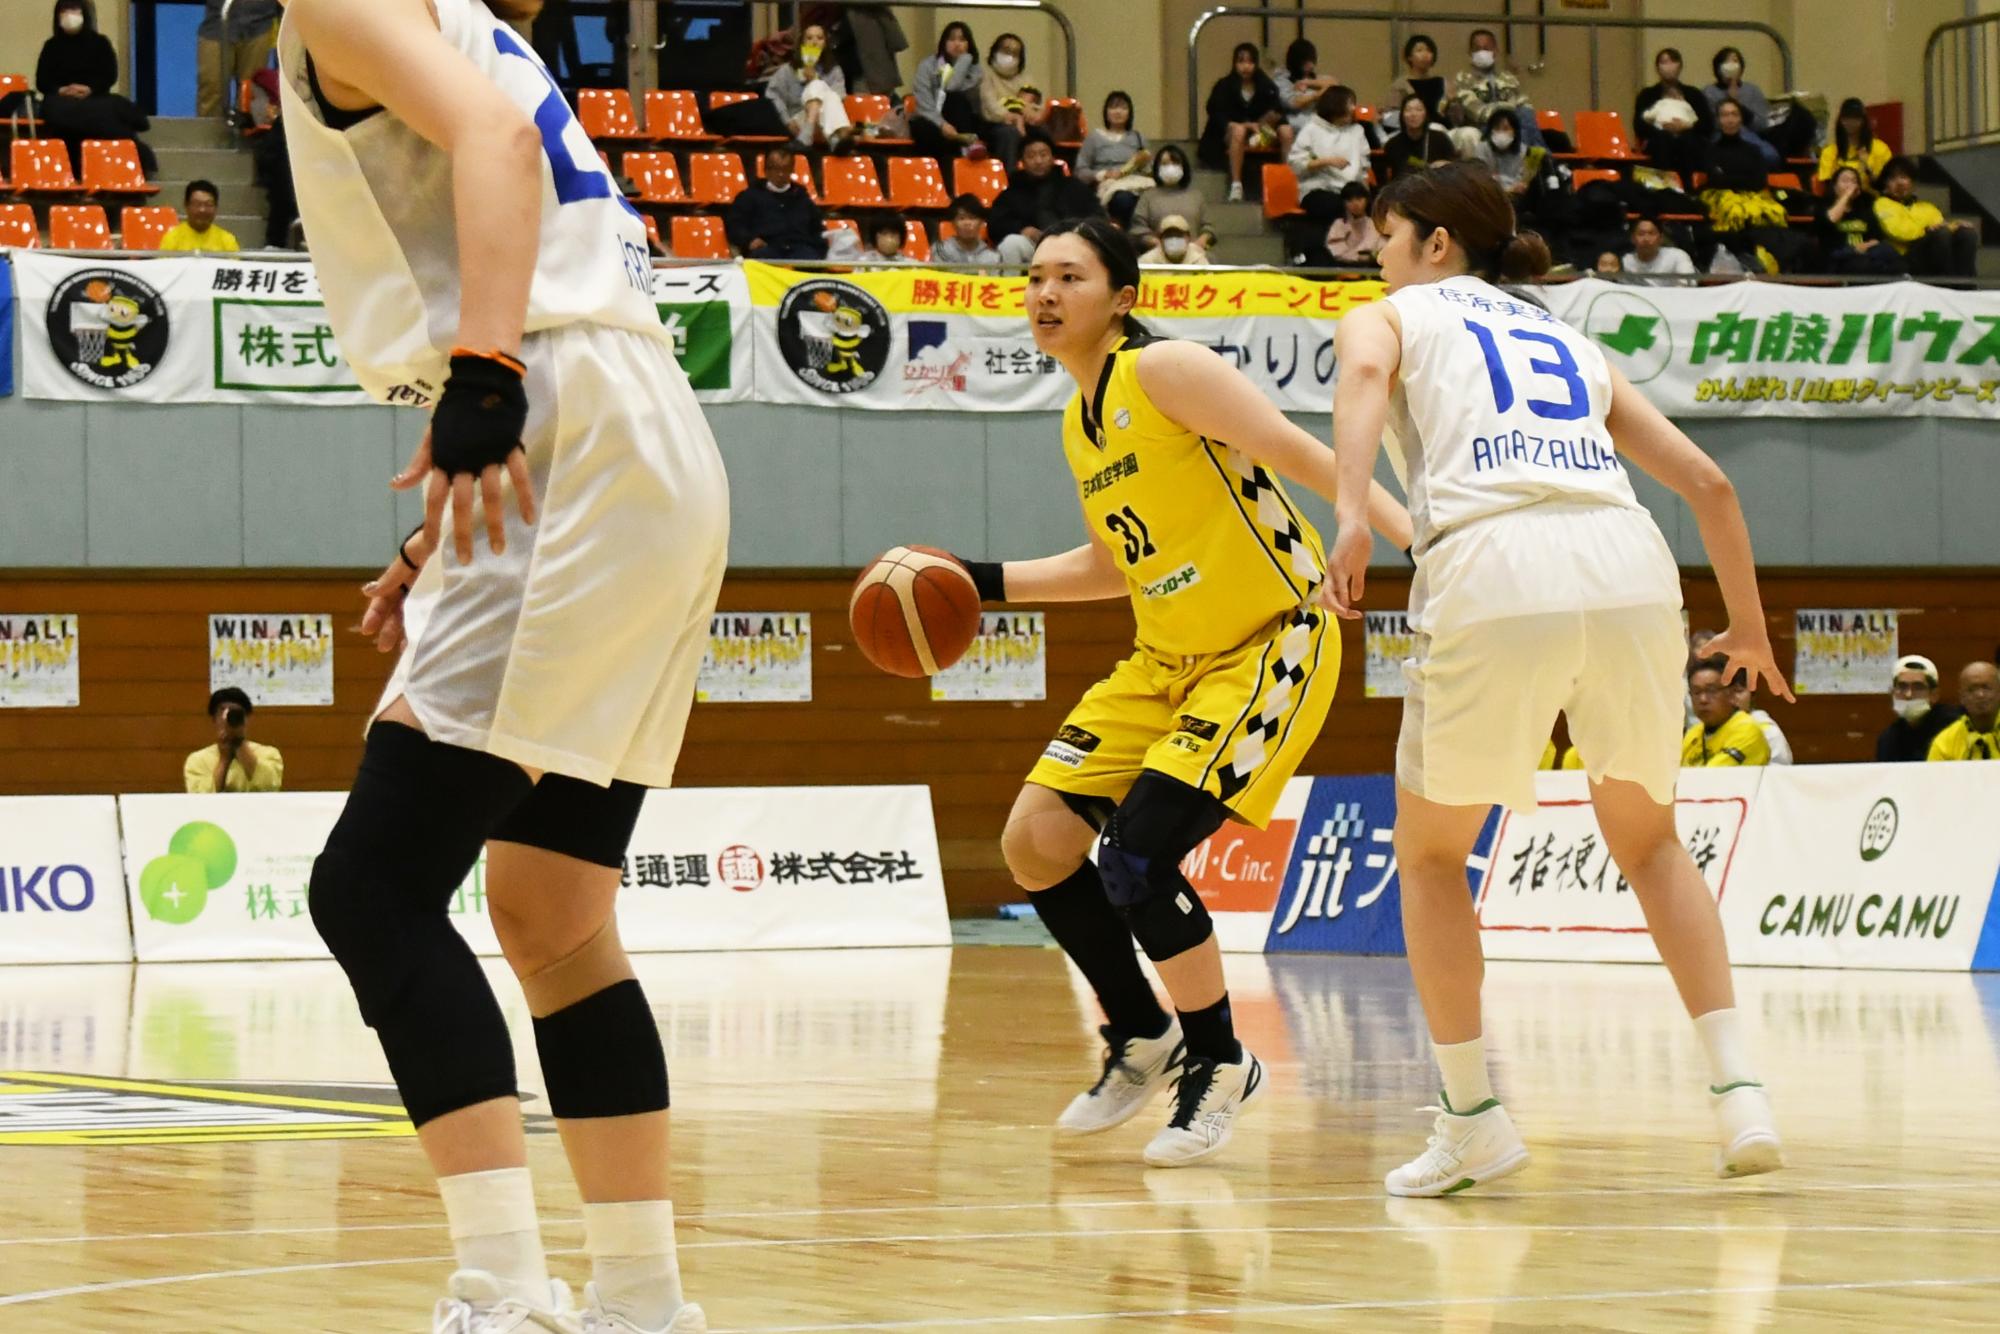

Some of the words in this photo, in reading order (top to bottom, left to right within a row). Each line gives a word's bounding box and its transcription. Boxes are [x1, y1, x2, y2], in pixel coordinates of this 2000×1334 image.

[211, 267, 316, 294] 勝利を
[1463, 317, 1591, 421] 13
[1105, 504, 1157, 566] 31
[214, 619, 268, 639] WIN
[1798, 613, 1843, 632] WIN
[770, 850, 923, 885] 株式会社
